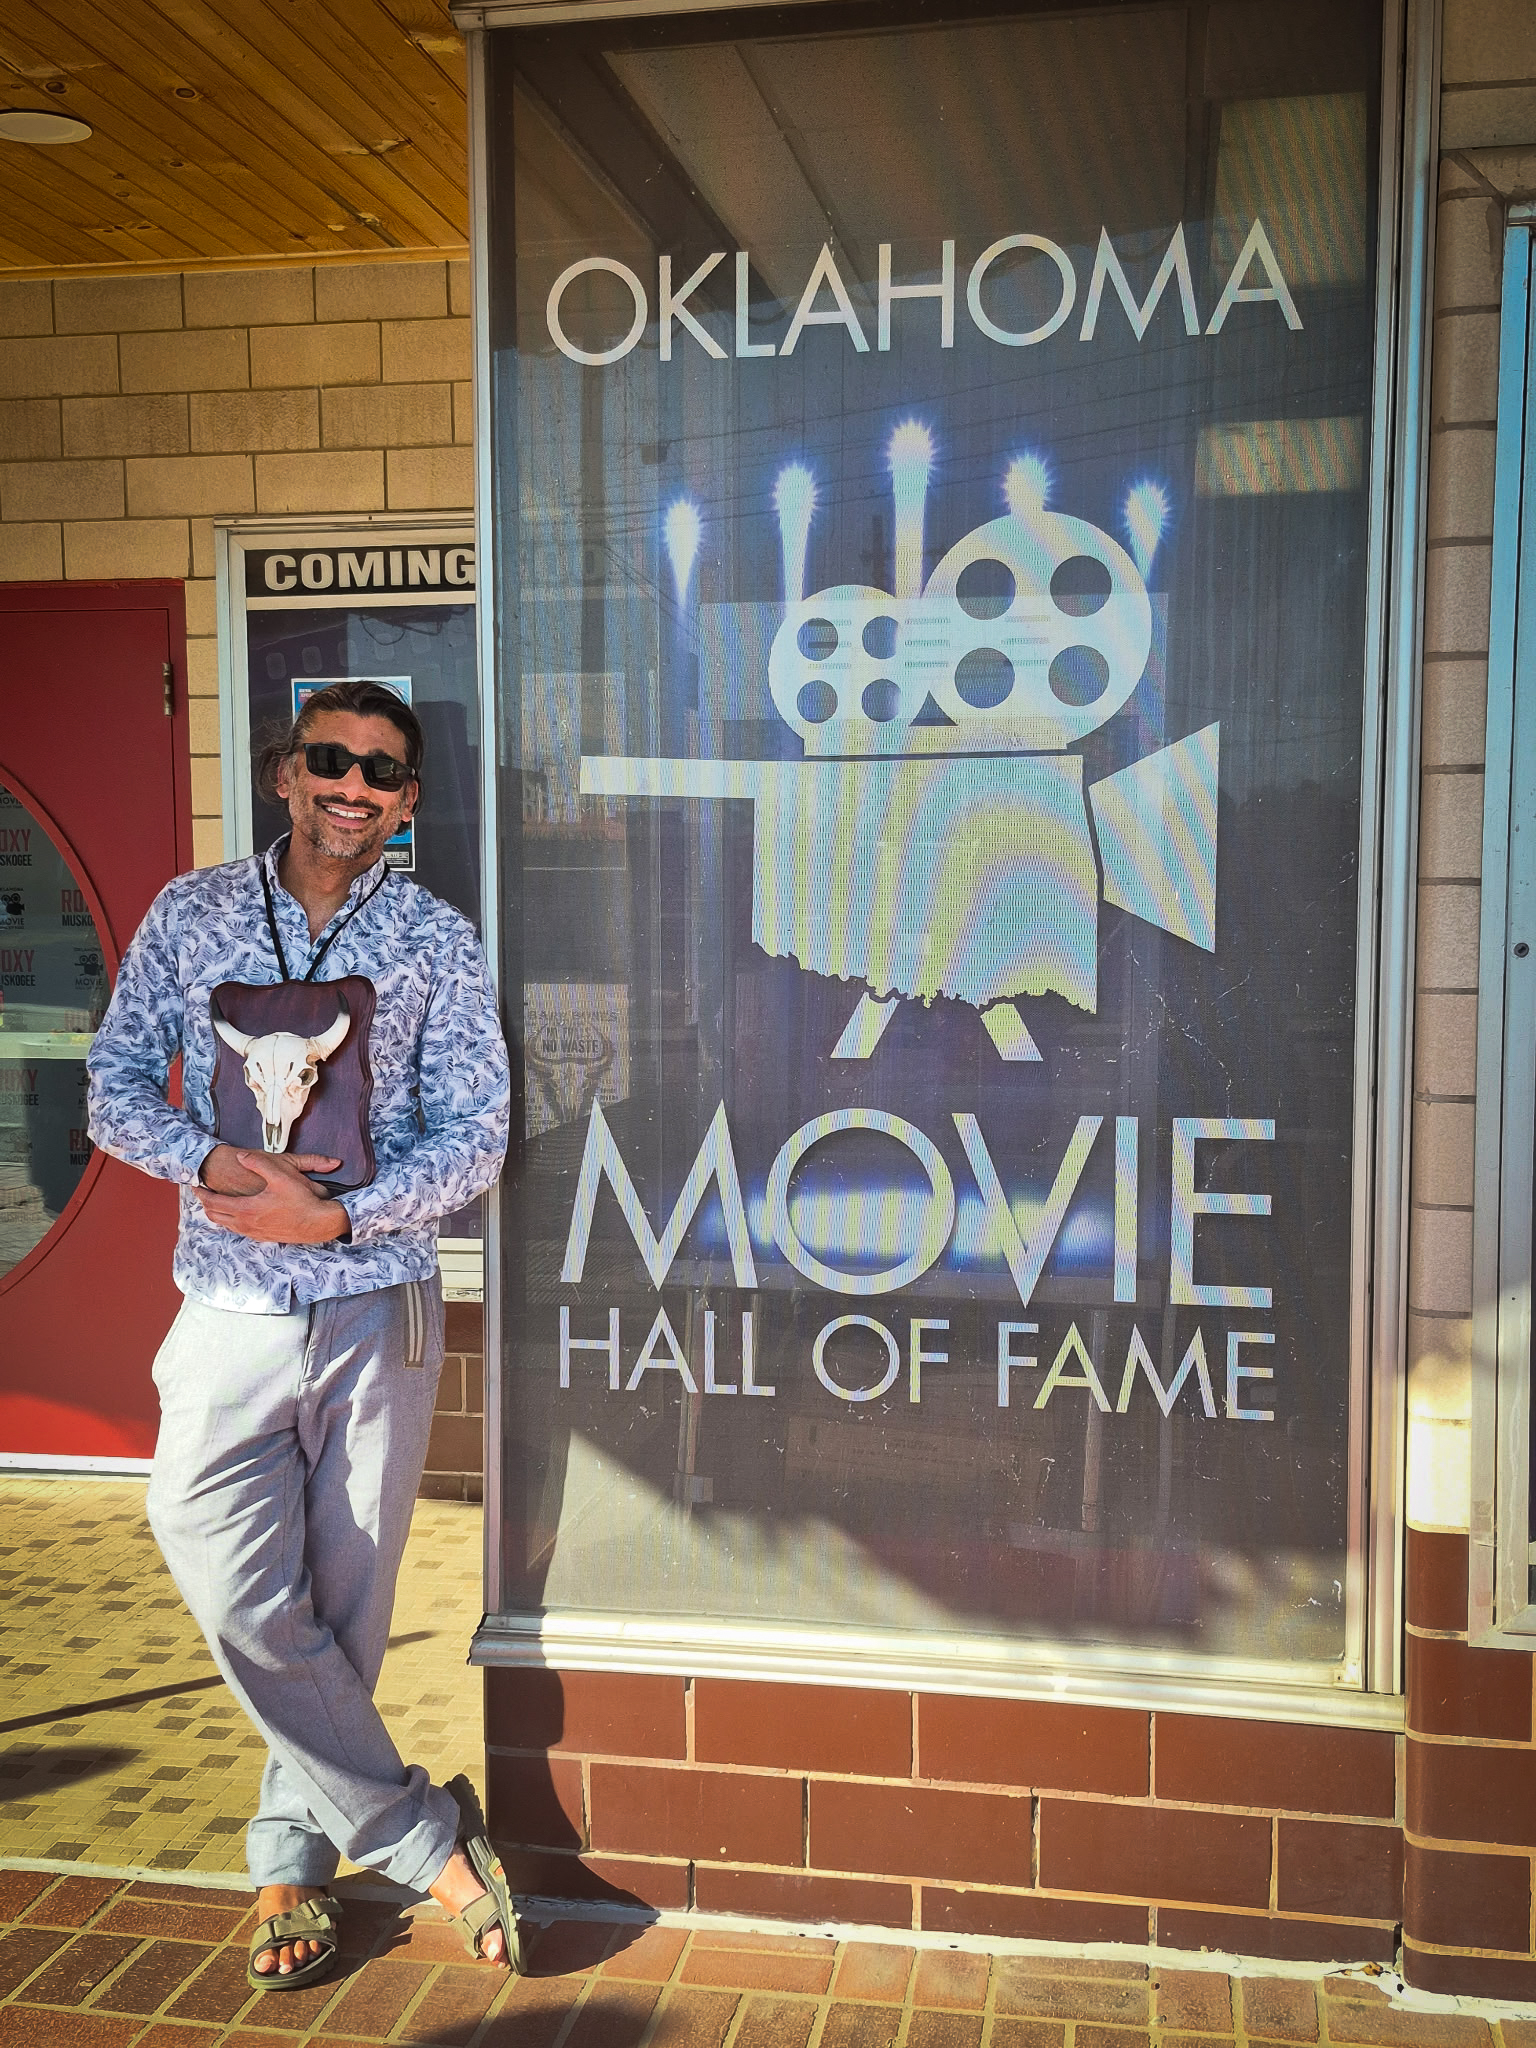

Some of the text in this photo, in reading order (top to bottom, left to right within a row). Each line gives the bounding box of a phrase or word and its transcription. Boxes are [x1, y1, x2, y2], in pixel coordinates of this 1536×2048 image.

[545, 217, 1305, 366] OKLAHOMA
[264, 549, 476, 590] COMING
[0, 829, 31, 852] OXY
[0, 854, 33, 867] SKOGEE
[61, 889, 89, 913] RO
[62, 914, 94, 927] MUSKO
[1, 949, 35, 973] OXY
[1, 974, 36, 987] SKOGEE
[543, 1039, 599, 1054] NO WASTE
[0, 1069, 38, 1091] OXY
[560, 1098, 1276, 1309] MOVIE
[559, 1305, 1276, 1422] HALL OF FAME
